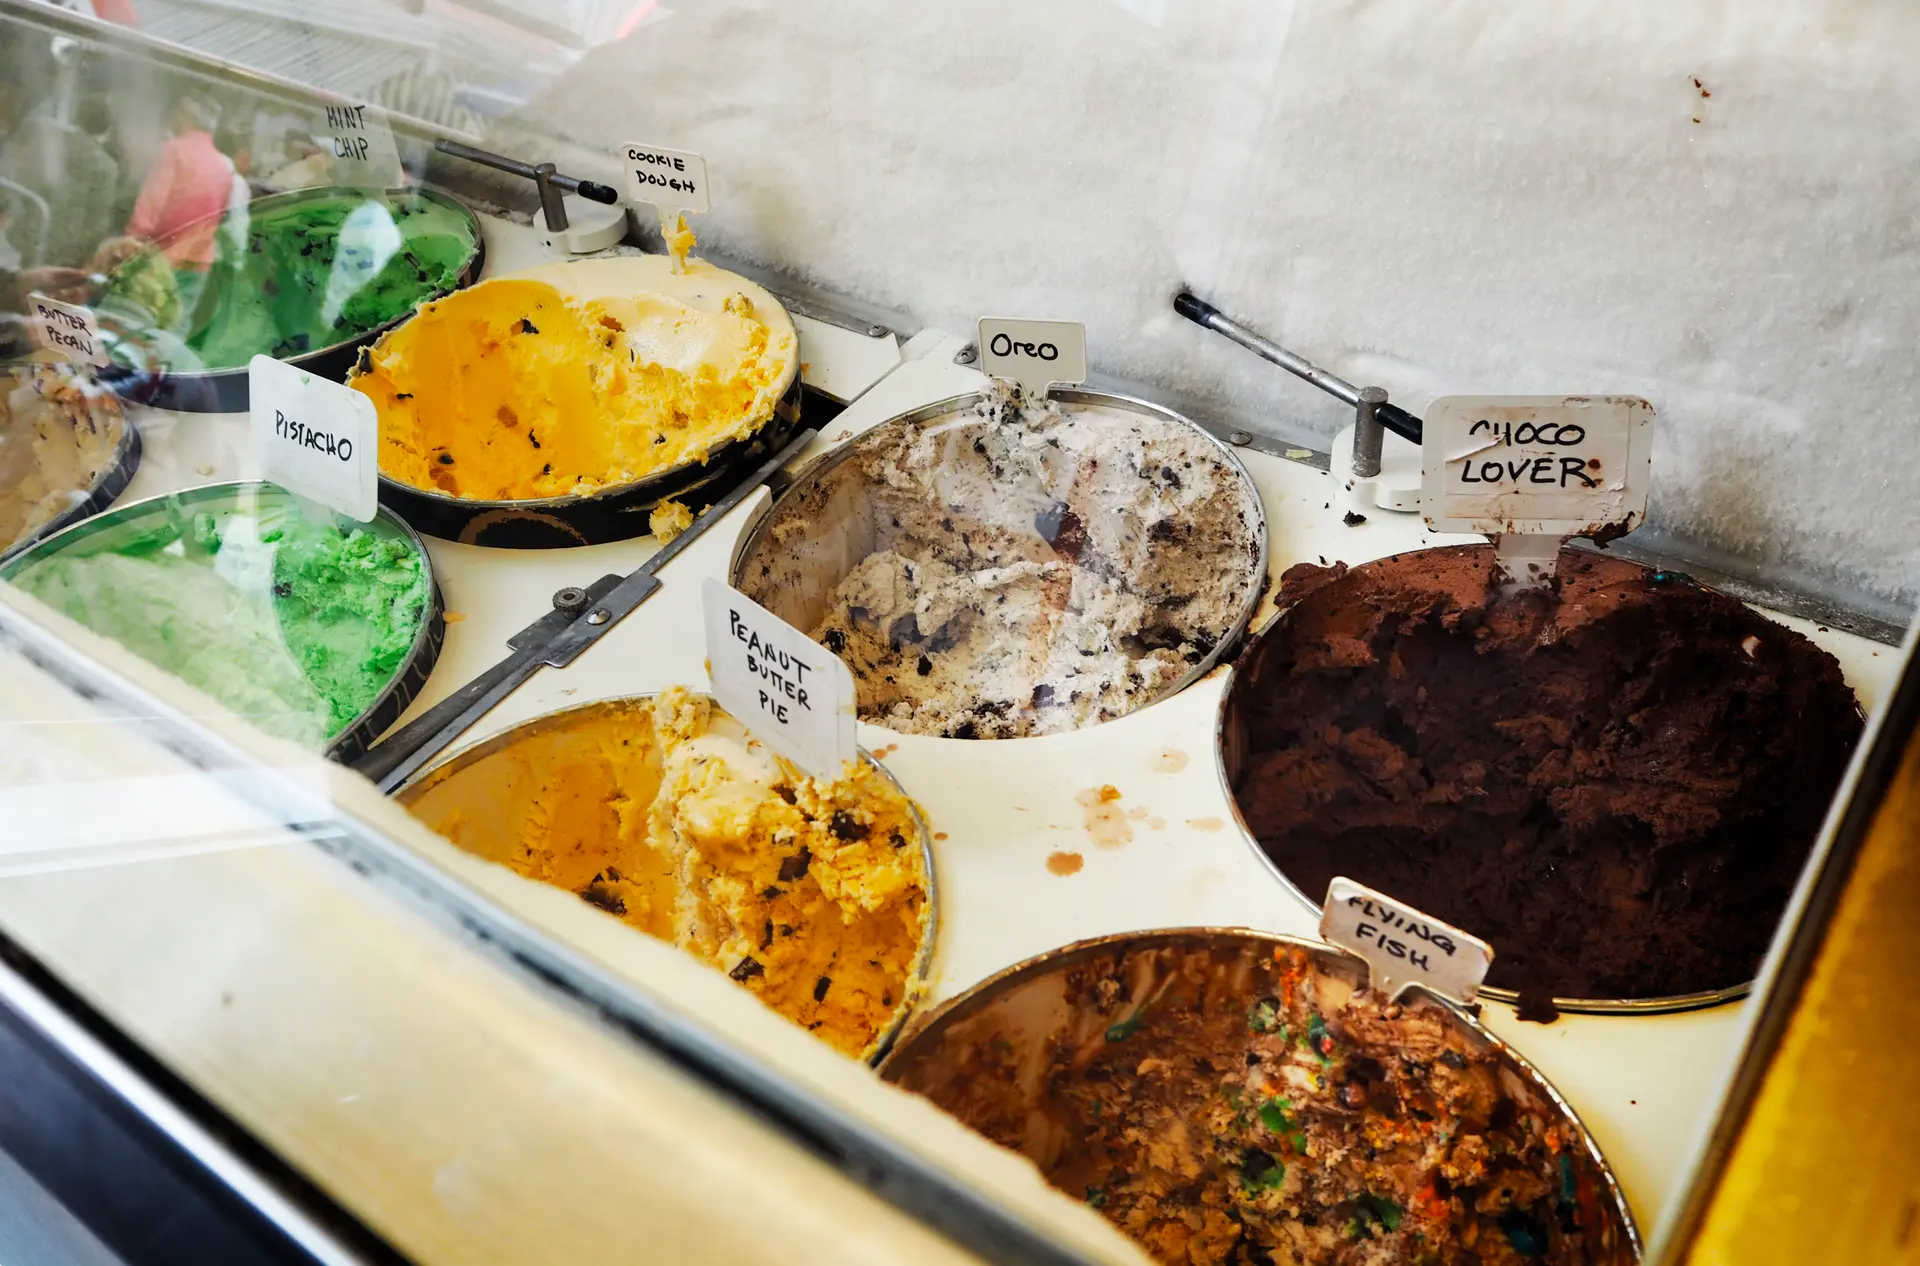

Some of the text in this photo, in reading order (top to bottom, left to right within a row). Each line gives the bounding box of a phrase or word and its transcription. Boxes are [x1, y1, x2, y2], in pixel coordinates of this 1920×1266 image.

[326, 105, 365, 130] MINT
[334, 136, 368, 161] CHIP
[628, 149, 685, 171] COOKIE
[636, 169, 696, 194] DOUGH
[37, 304, 92, 337] BUTTER
[46, 325, 93, 356] PECAN
[990, 333, 1058, 361] Oreo
[275, 409, 352, 461] PISTACHO
[1461, 457, 1597, 488] LOVER
[729, 608, 812, 684] PEANUT
[746, 654, 812, 711] BUTTER
[758, 689, 789, 724] PIE
[1348, 896, 1457, 956] FLYING
[1356, 922, 1430, 971] FISH
